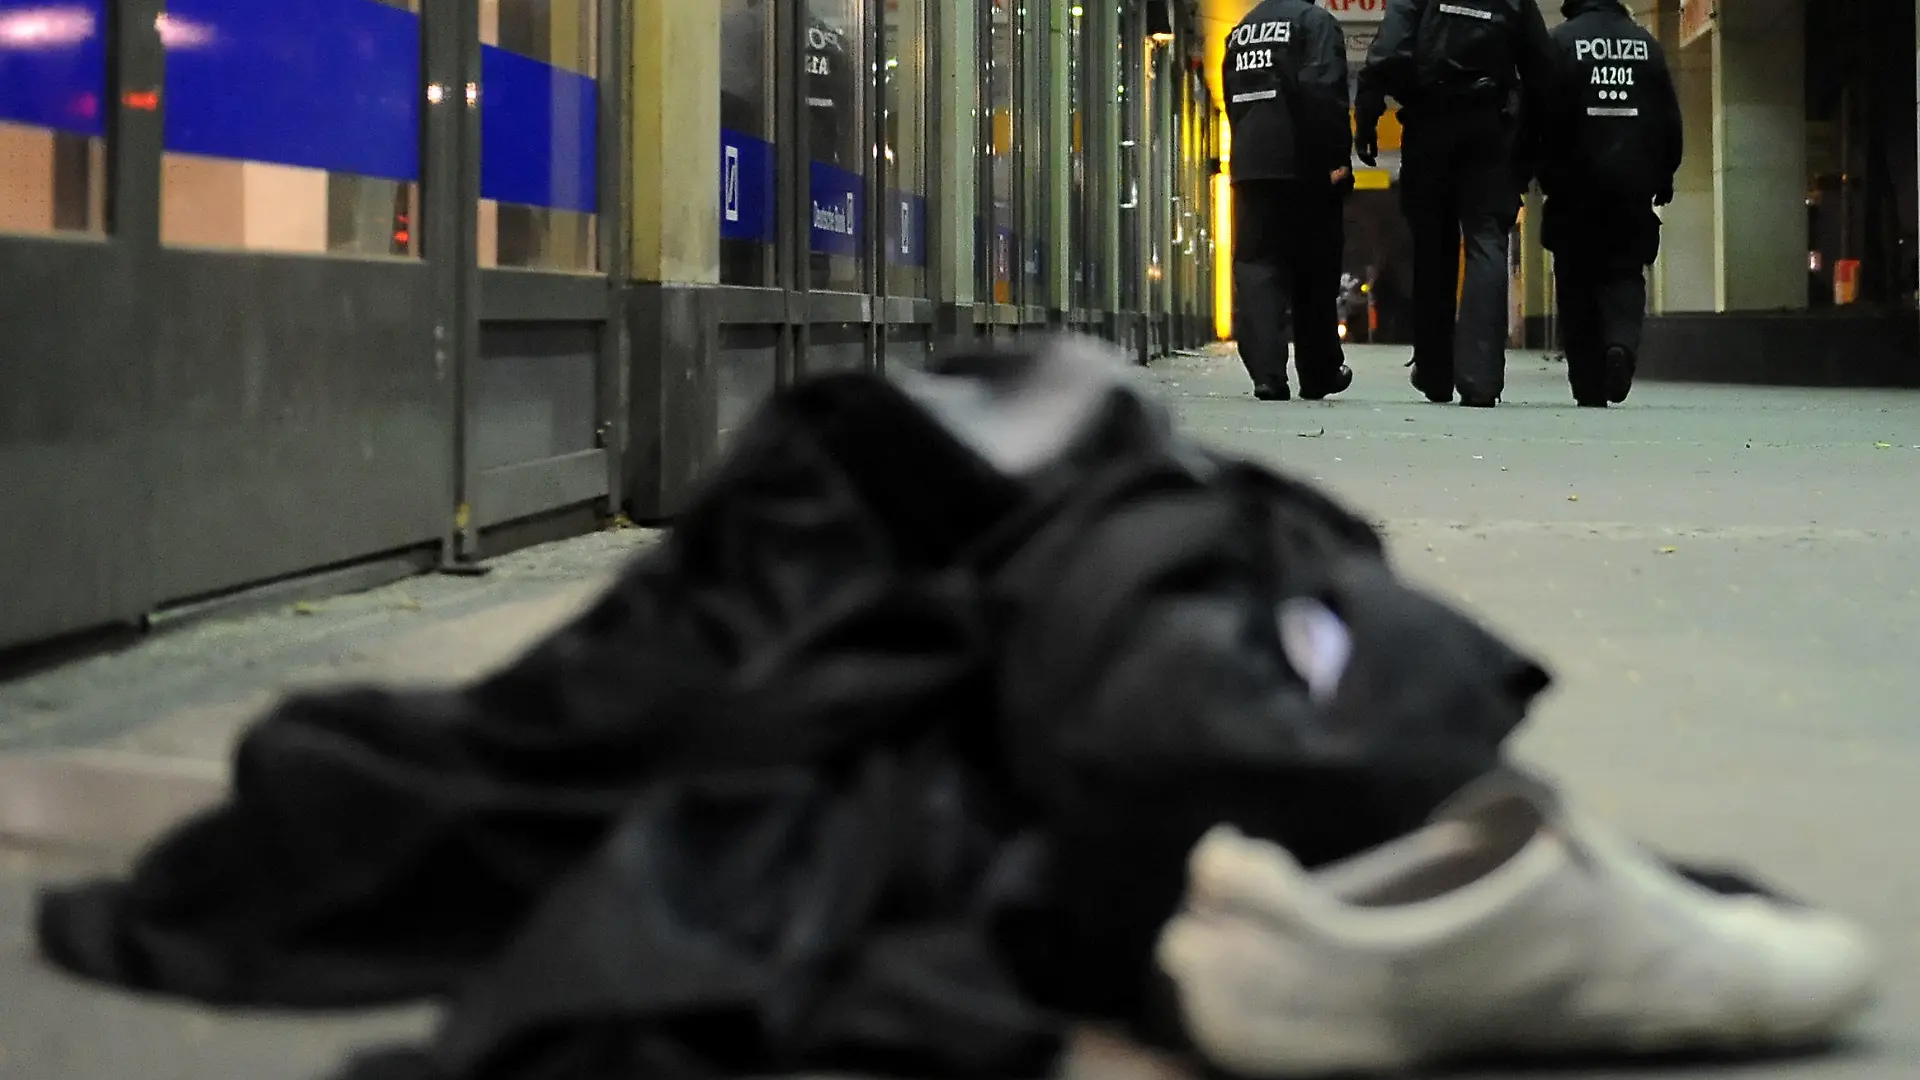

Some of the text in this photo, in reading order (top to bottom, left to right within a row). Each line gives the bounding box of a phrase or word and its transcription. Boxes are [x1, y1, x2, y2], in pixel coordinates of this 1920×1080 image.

[1228, 21, 1290, 48] POLIZEI
[1235, 48, 1273, 72] A1231
[1575, 38, 1648, 60] POLIZEI
[1590, 66, 1634, 85] A1201
